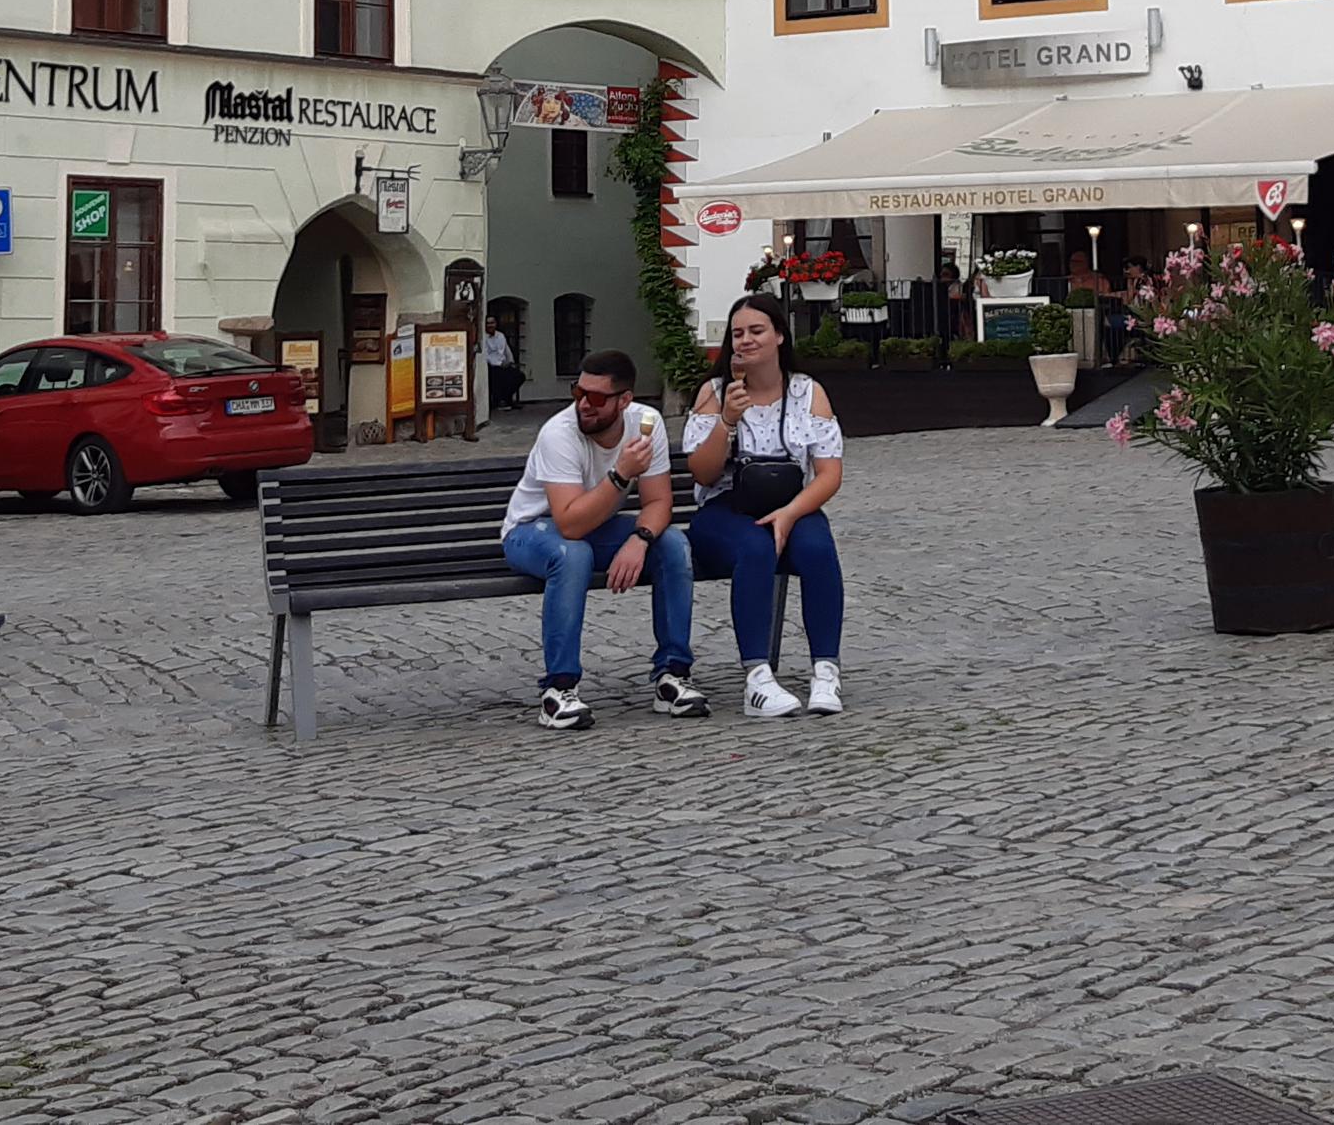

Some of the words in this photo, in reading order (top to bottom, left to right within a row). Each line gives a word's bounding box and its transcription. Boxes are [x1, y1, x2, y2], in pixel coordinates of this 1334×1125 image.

[951, 49, 1026, 72] HOTEL
[1036, 42, 1132, 66] GRAND
[204, 80, 295, 125] Maštal
[298, 97, 437, 134] RESTAURACE
[213, 124, 292, 147] PENZION
[869, 192, 978, 210] RESTAURANT
[982, 189, 1037, 206] HOTEL
[1042, 186, 1105, 204] GRAND
[75, 205, 106, 232] SHOP
